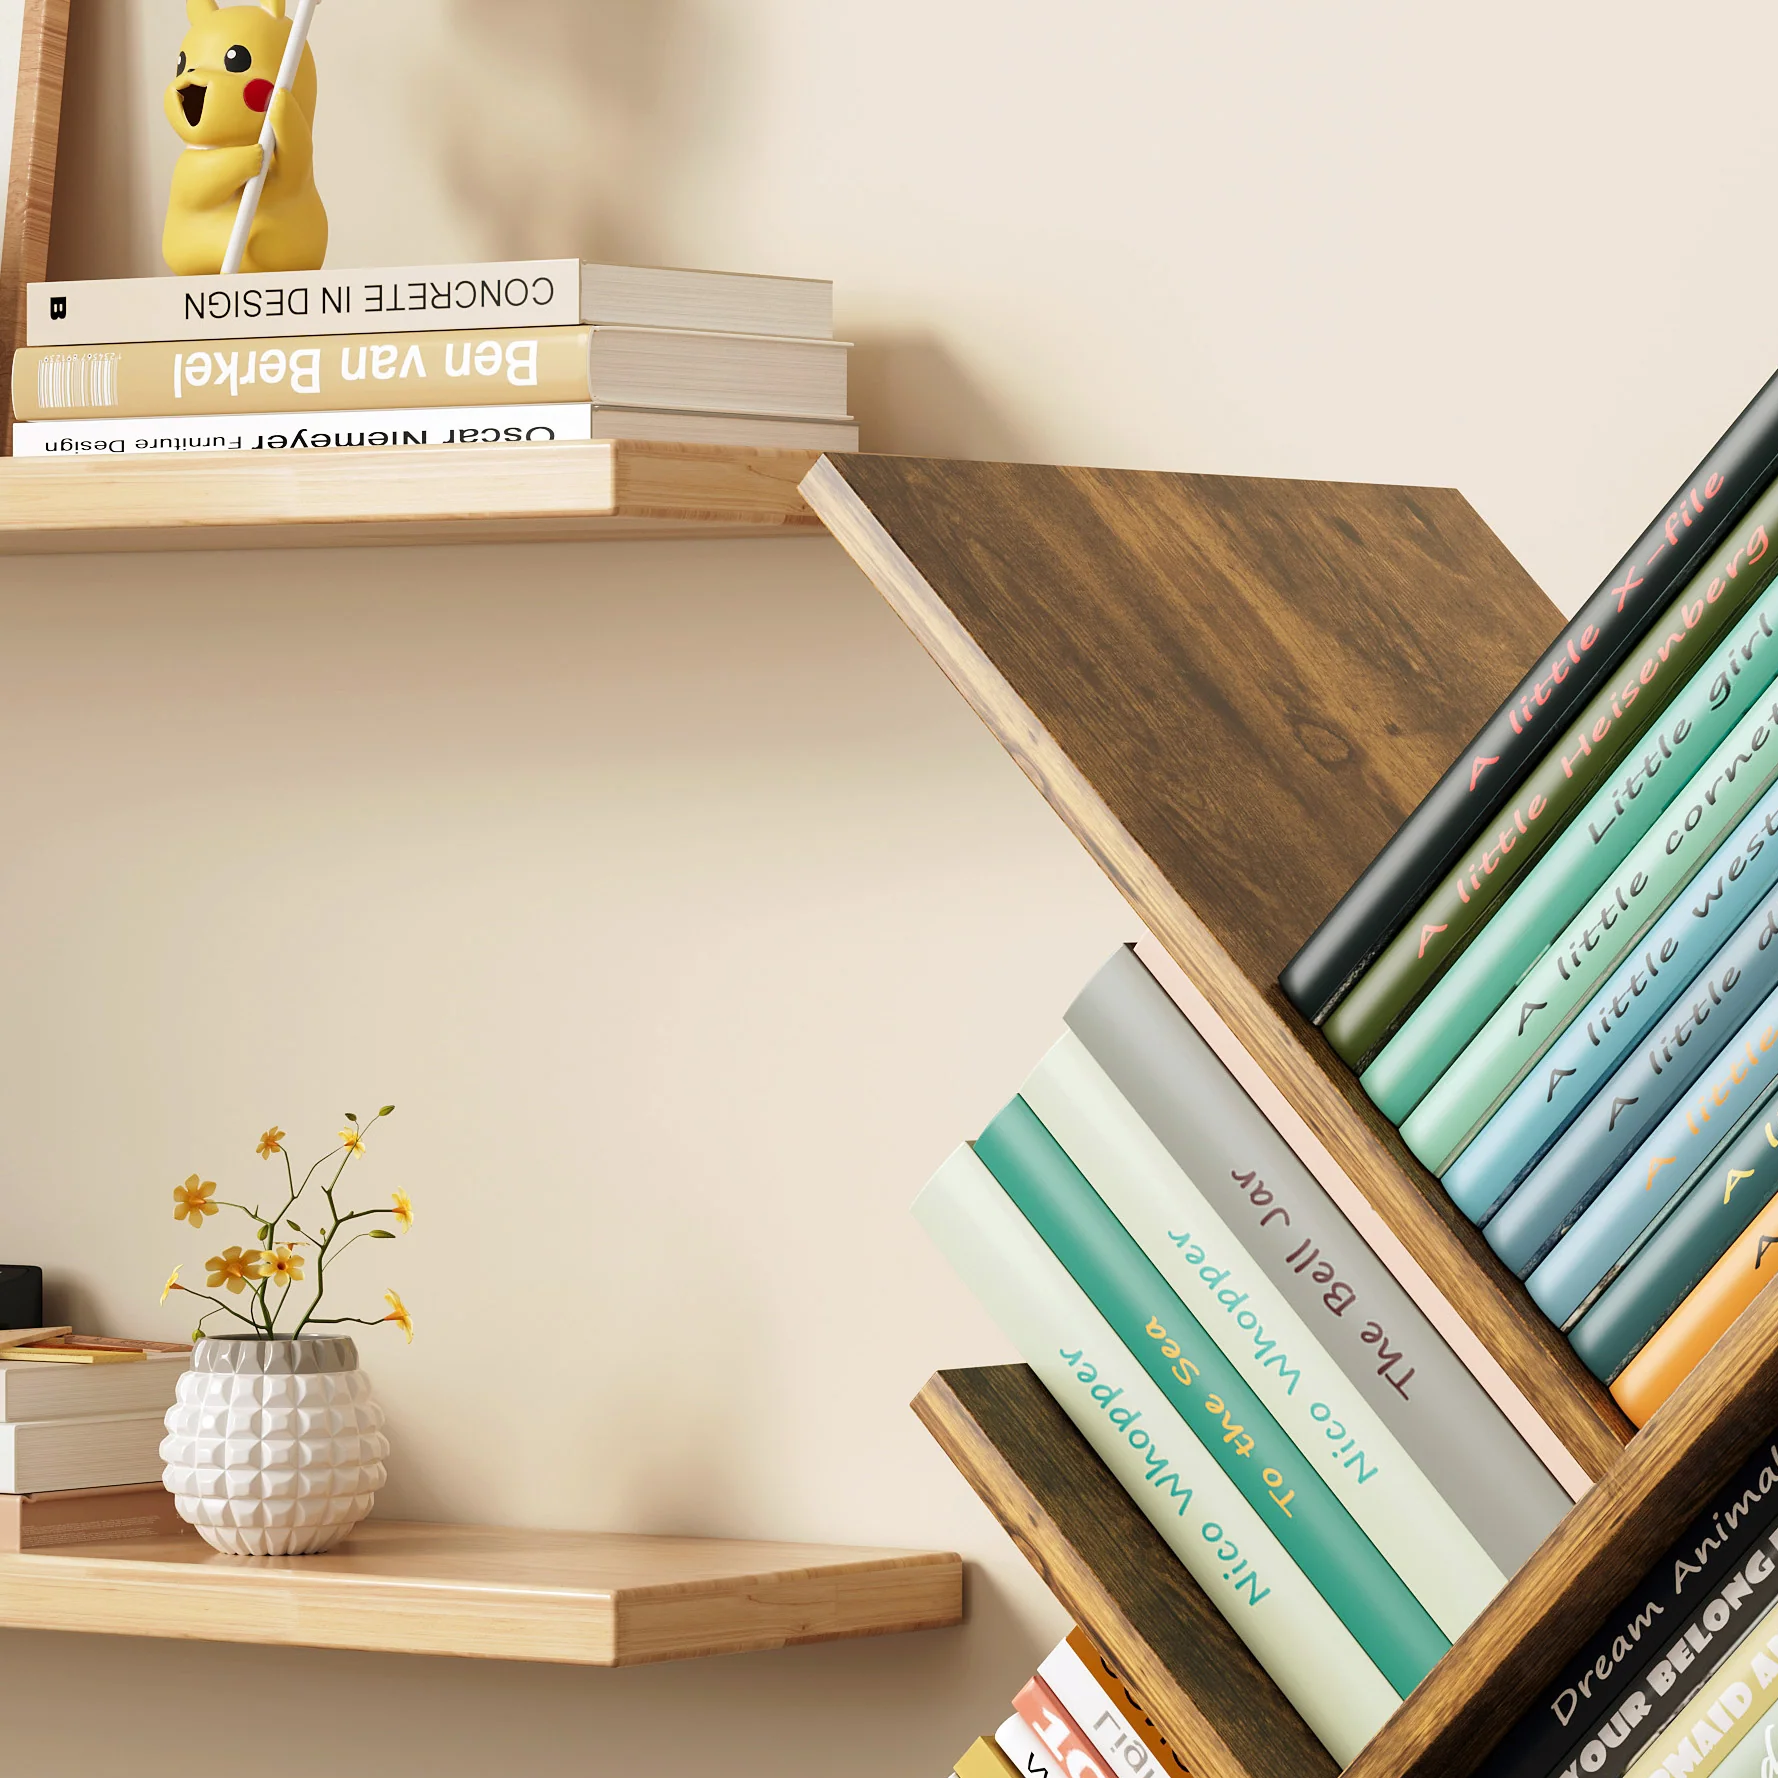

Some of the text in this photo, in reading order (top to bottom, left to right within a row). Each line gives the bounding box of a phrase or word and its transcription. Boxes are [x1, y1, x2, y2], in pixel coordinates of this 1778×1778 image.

[50, 295, 67, 321] B
[173, 340, 538, 398] Ben van Berkel
[185, 277, 555, 320] CONCRETE IN DESIGN
[45, 438, 126, 457] Design
[135, 436, 242, 453] Furniture
[1469, 474, 1724, 791] A little X-file
[1417, 923, 1448, 958] A
[1458, 795, 1547, 903] little
[1563, 527, 1768, 778] Heisenberg
[1583, 610, 1777, 846] Little girl
[1517, 1001, 1548, 1036] A
[1558, 872, 1648, 980] little
[1546, 1067, 1577, 1102] A
[1588, 938, 1678, 1046] little
[1608, 1096, 1639, 1132] A
[1653, 970, 1741, 1075] little
[1645, 1155, 1676, 1191] A
[1685, 1025, 1778, 1135] little
[1723, 1168, 1755, 1204] A
[1167, 1230, 1378, 1484] Nico Whopper
[1231, 1170, 1414, 1400] The Bell Jar
[1059, 1348, 1270, 1606] Nico Whopper
[1145, 1315, 1294, 1517] To the Sea
[1550, 1601, 1664, 1726] Dream
[1646, 1549, 1775, 1696] BELONG
